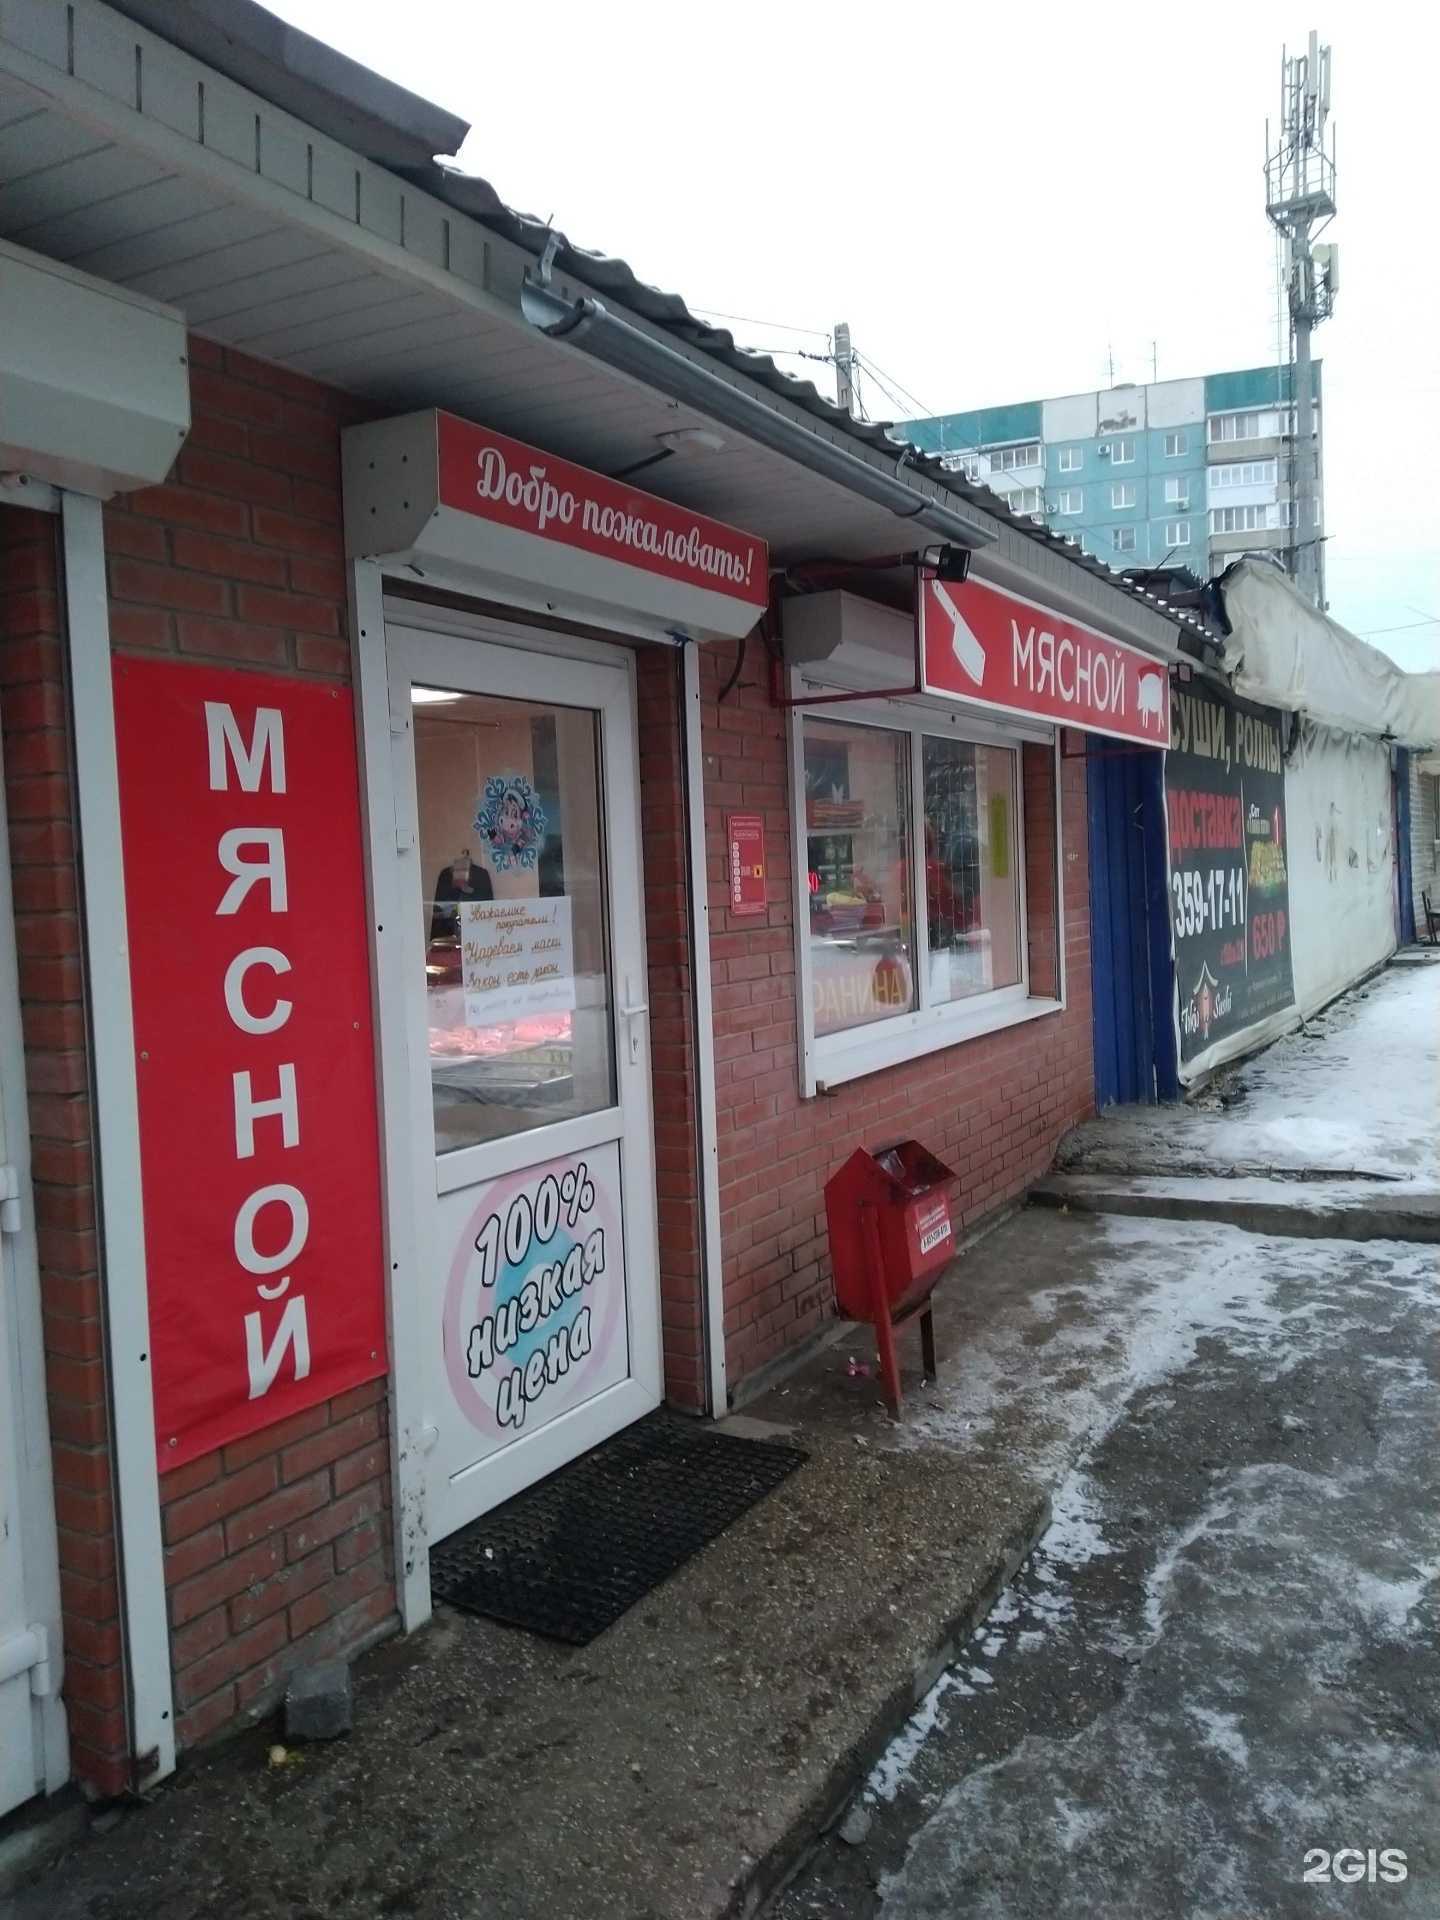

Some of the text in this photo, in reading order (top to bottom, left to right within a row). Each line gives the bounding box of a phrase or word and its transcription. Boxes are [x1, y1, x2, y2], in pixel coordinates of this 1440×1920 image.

[477, 447, 754, 586] Добро пожаловать!
[1010, 618, 1126, 717] МЯСНОЙ
[1235, 711, 1281, 775] РОЛЛЫ
[1173, 867, 1244, 938] 359-17-11
[203, 700, 310, 1400] МЯСНОЙ
[475, 1161, 595, 1288] 100%
[467, 1228, 605, 1378] низкая
[496, 1306, 592, 1429] цена
